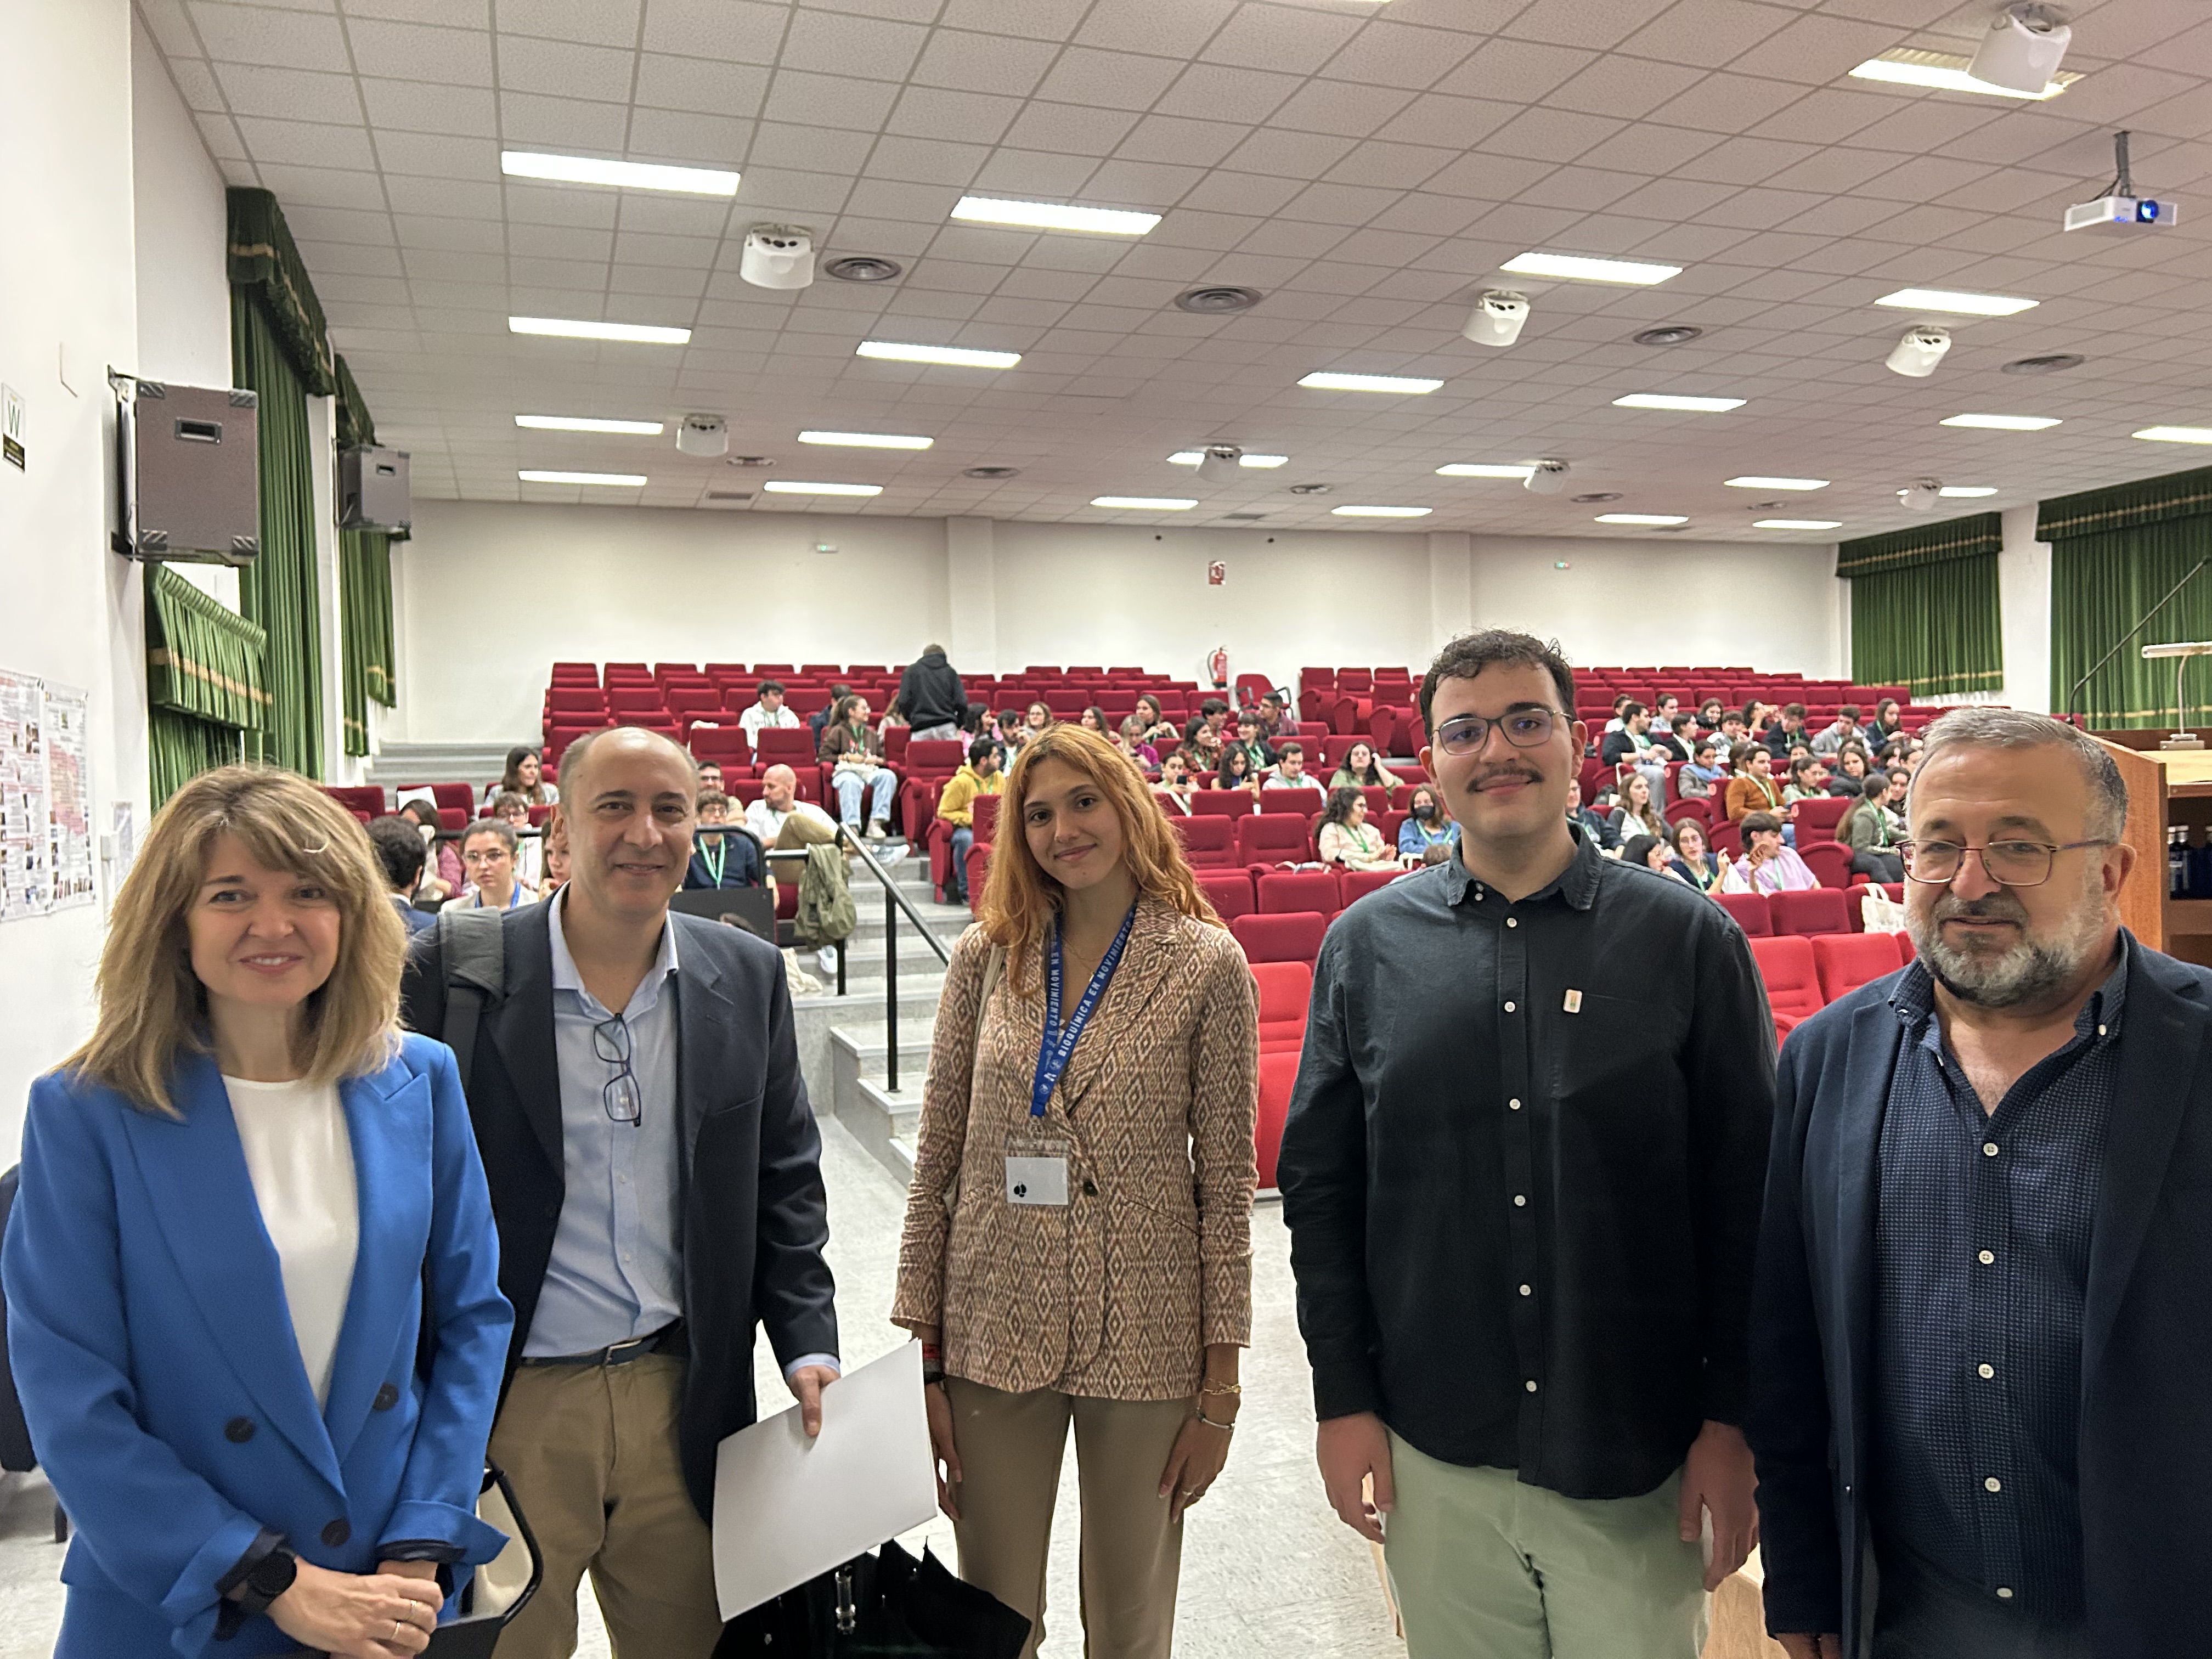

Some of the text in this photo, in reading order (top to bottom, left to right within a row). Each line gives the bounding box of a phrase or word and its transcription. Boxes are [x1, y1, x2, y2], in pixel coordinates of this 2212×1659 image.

[1051, 952, 1059, 964] EN
[1048, 969, 1060, 1026] MOVIMIENTO
[1058, 921, 1131, 1057] BIOQUÍMICA EN MOVIMIENTO
